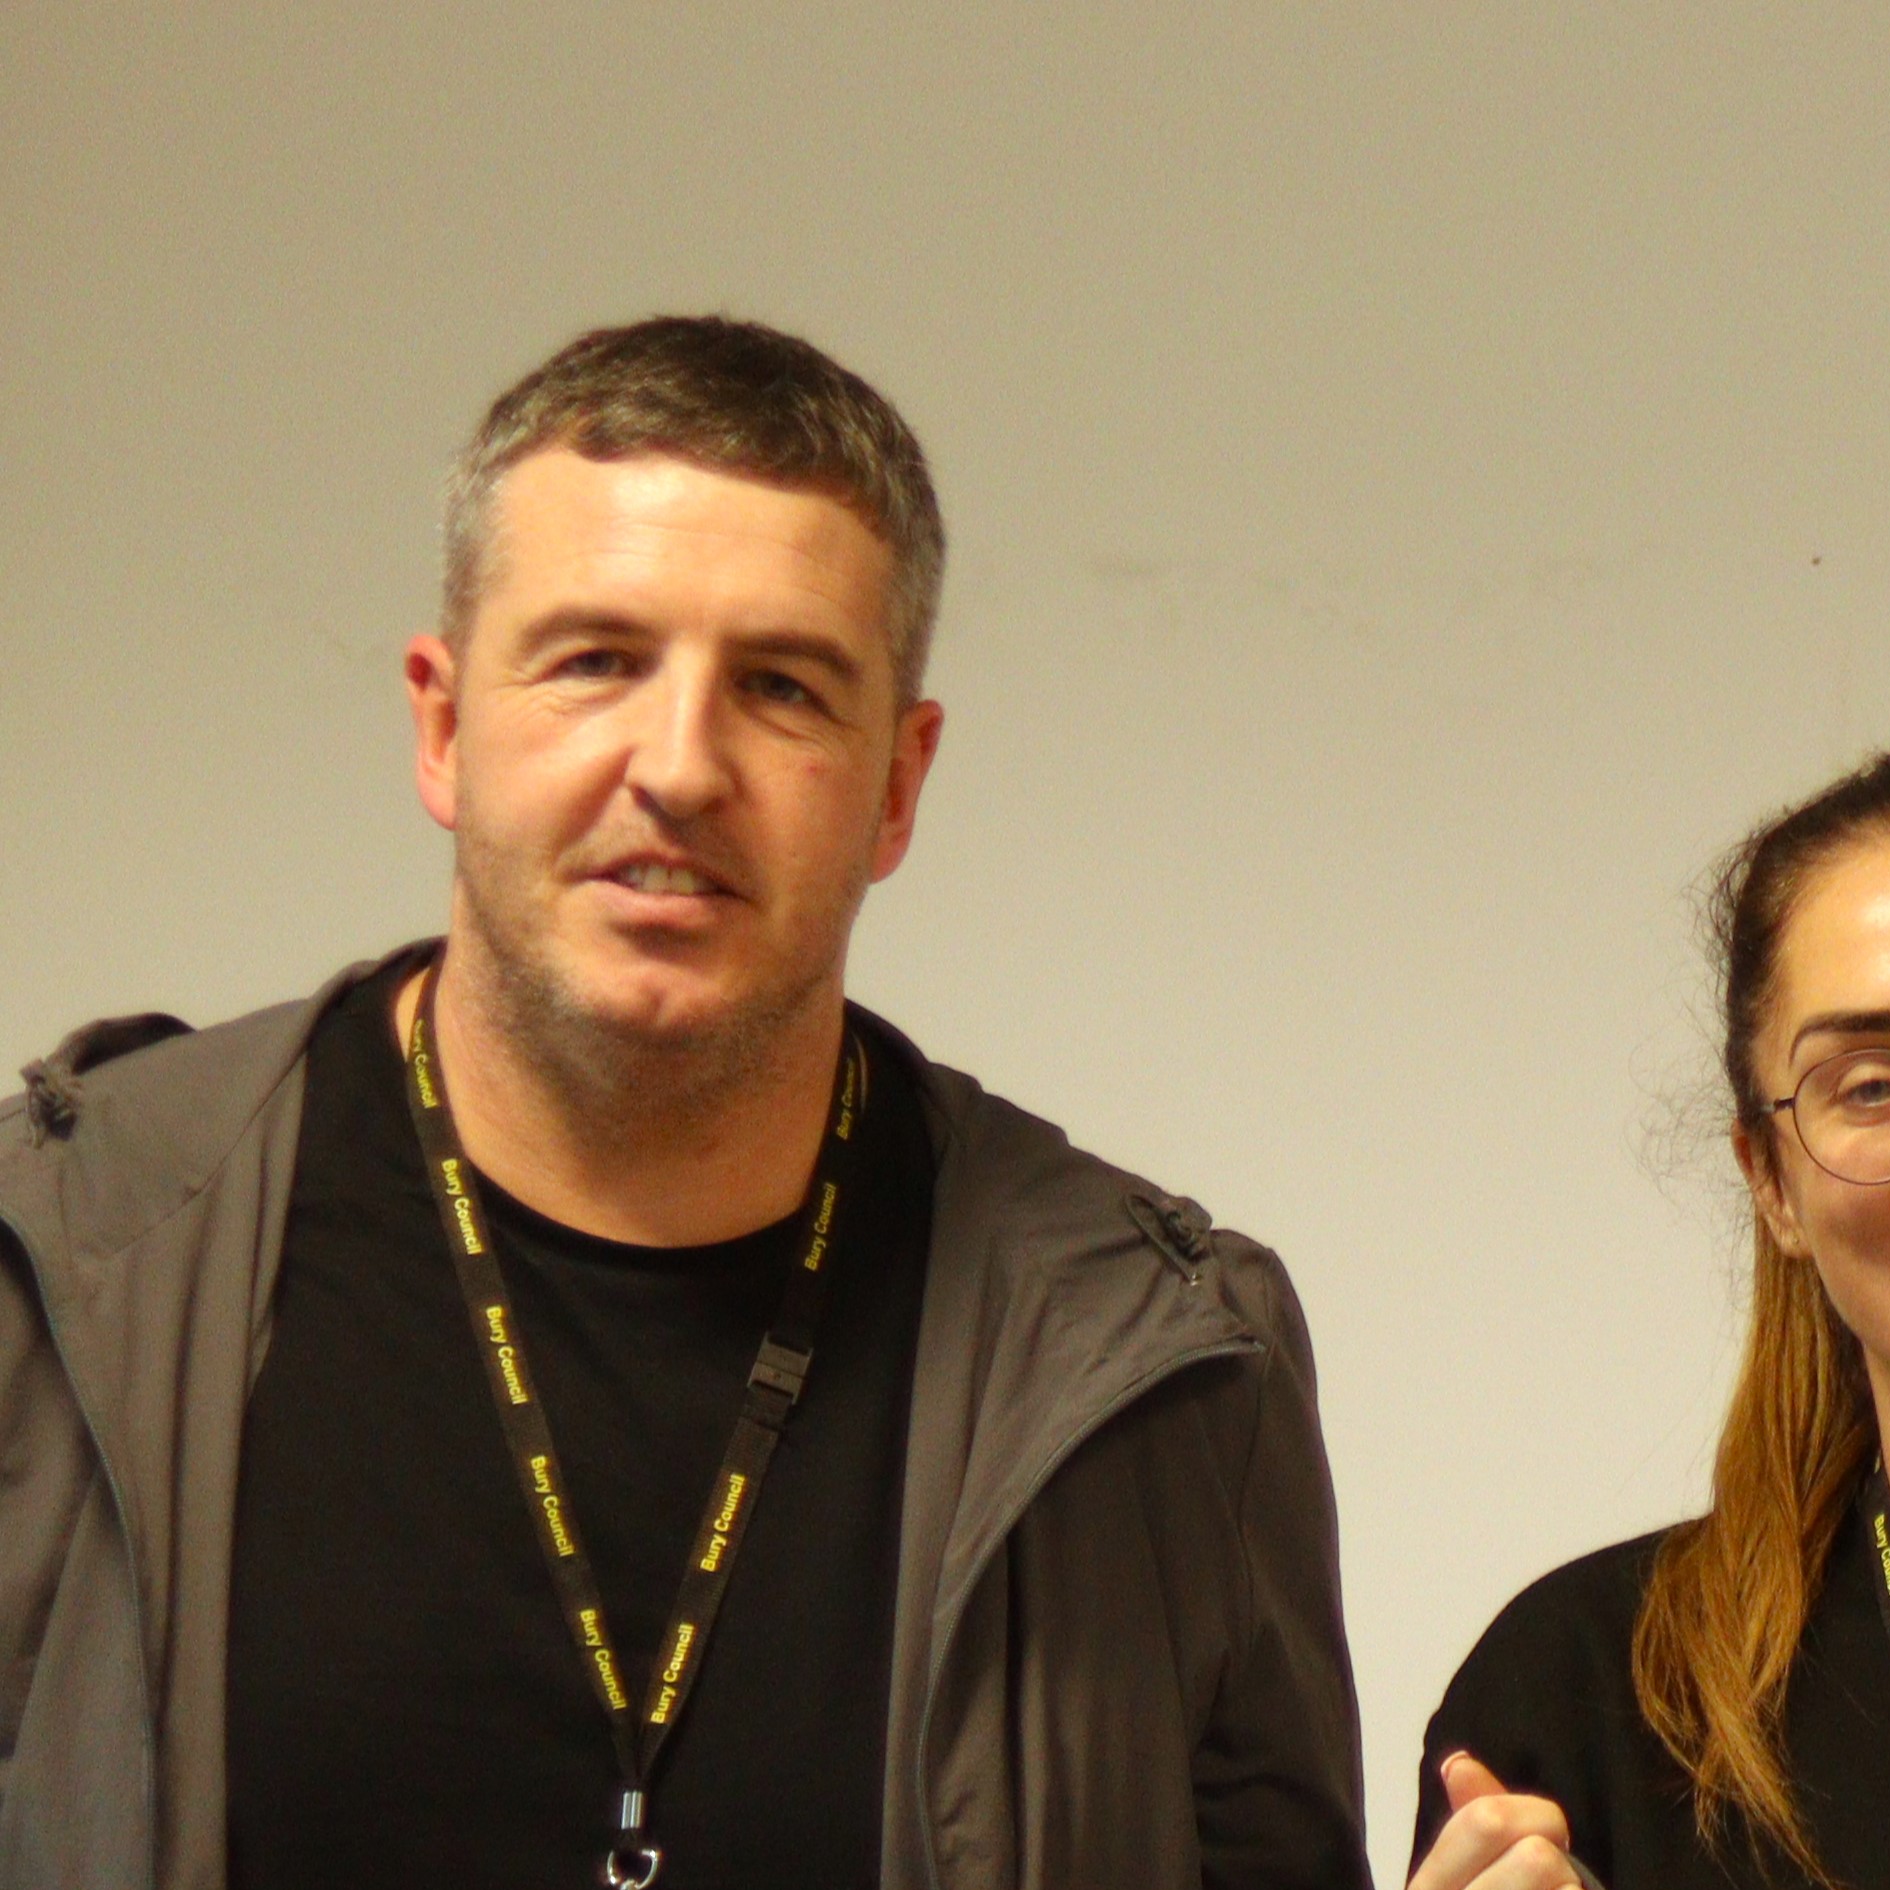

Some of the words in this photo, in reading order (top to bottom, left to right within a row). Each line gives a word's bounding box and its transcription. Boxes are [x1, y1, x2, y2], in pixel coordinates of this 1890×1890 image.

[442, 1158, 462, 1196] Bury
[454, 1197, 484, 1255] Council
[814, 1182, 838, 1235] Council
[804, 1236, 827, 1272] Bury
[486, 1306, 507, 1343] Bury
[498, 1346, 528, 1405] Council
[530, 1455, 551, 1494] Bury
[543, 1495, 575, 1557] Council
[700, 1534, 727, 1572] Bury
[714, 1473, 746, 1532] Council
[1873, 1514, 1888, 1549] Bury
[579, 1609, 603, 1647] Bury
[595, 1649, 628, 1710] Council
[663, 1623, 695, 1684] Council
[651, 1686, 676, 1724] Bury
